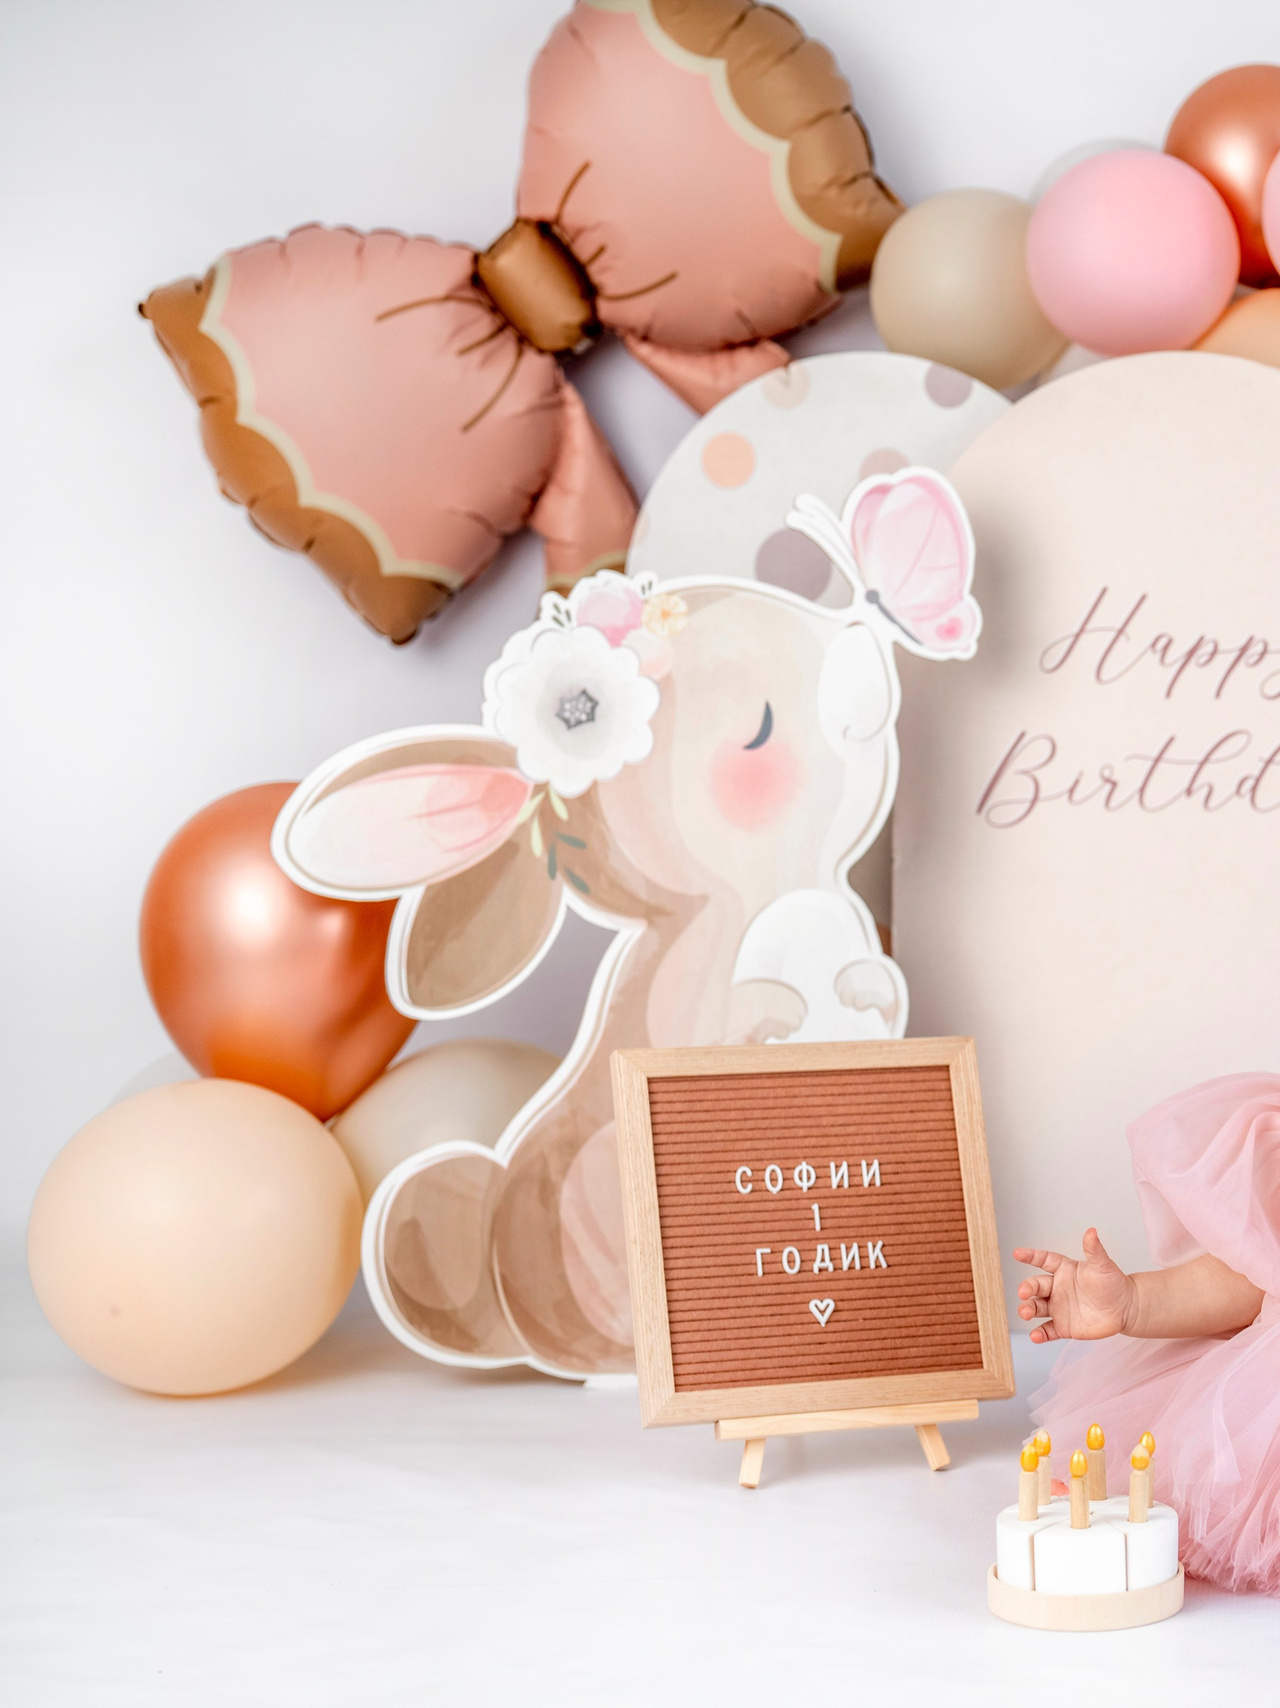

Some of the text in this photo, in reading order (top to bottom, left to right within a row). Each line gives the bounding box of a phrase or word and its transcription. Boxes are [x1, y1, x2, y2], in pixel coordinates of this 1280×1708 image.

[735, 1159, 881, 1195] СОФИИ
[811, 1203, 821, 1232] 1
[755, 1240, 888, 1278] ГОДИК
